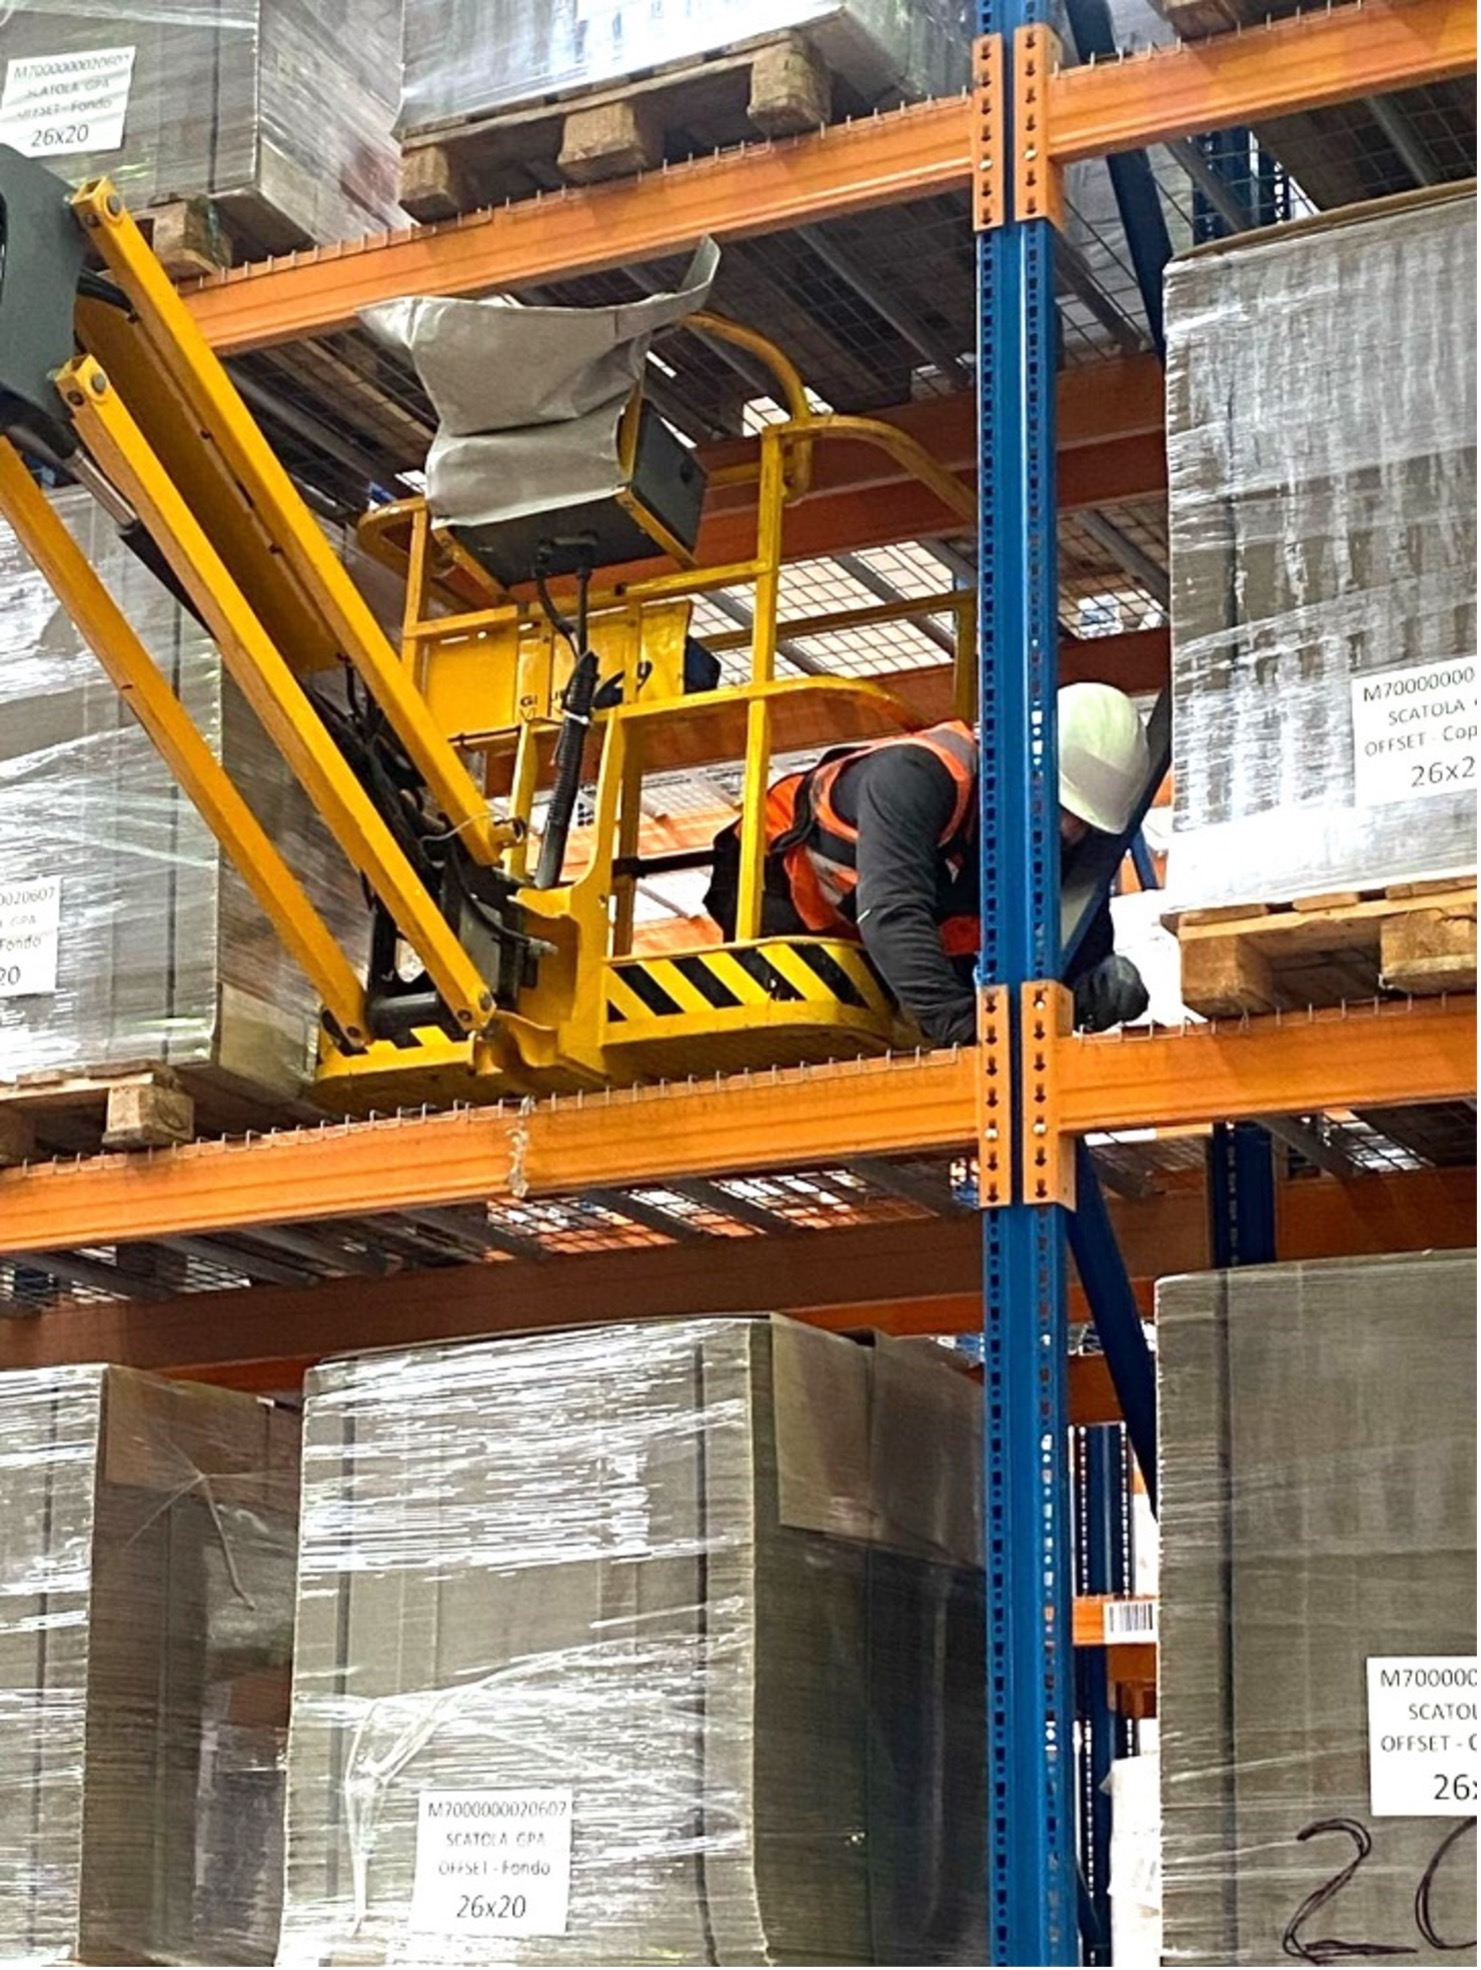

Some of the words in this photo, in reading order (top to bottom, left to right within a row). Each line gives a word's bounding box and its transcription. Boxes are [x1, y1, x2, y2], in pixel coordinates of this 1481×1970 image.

[31, 124, 89, 148] 26x20
[1363, 666, 1475, 702] M70000000
[1388, 698, 1466, 726] SCATOLA
[1364, 731, 1426, 757] OFFSET
[1411, 755, 1475, 788] 26x2
[1380, 1734, 1450, 1752] OFFSET
[428, 1801, 566, 1818] M7000000020607
[446, 1832, 508, 1847] SCATOLA
[516, 1832, 545, 1847] GPA
[438, 1861, 488, 1876] OFFSET
[502, 1860, 551, 1876] Fondo
[456, 1894, 527, 1919] 26x20
